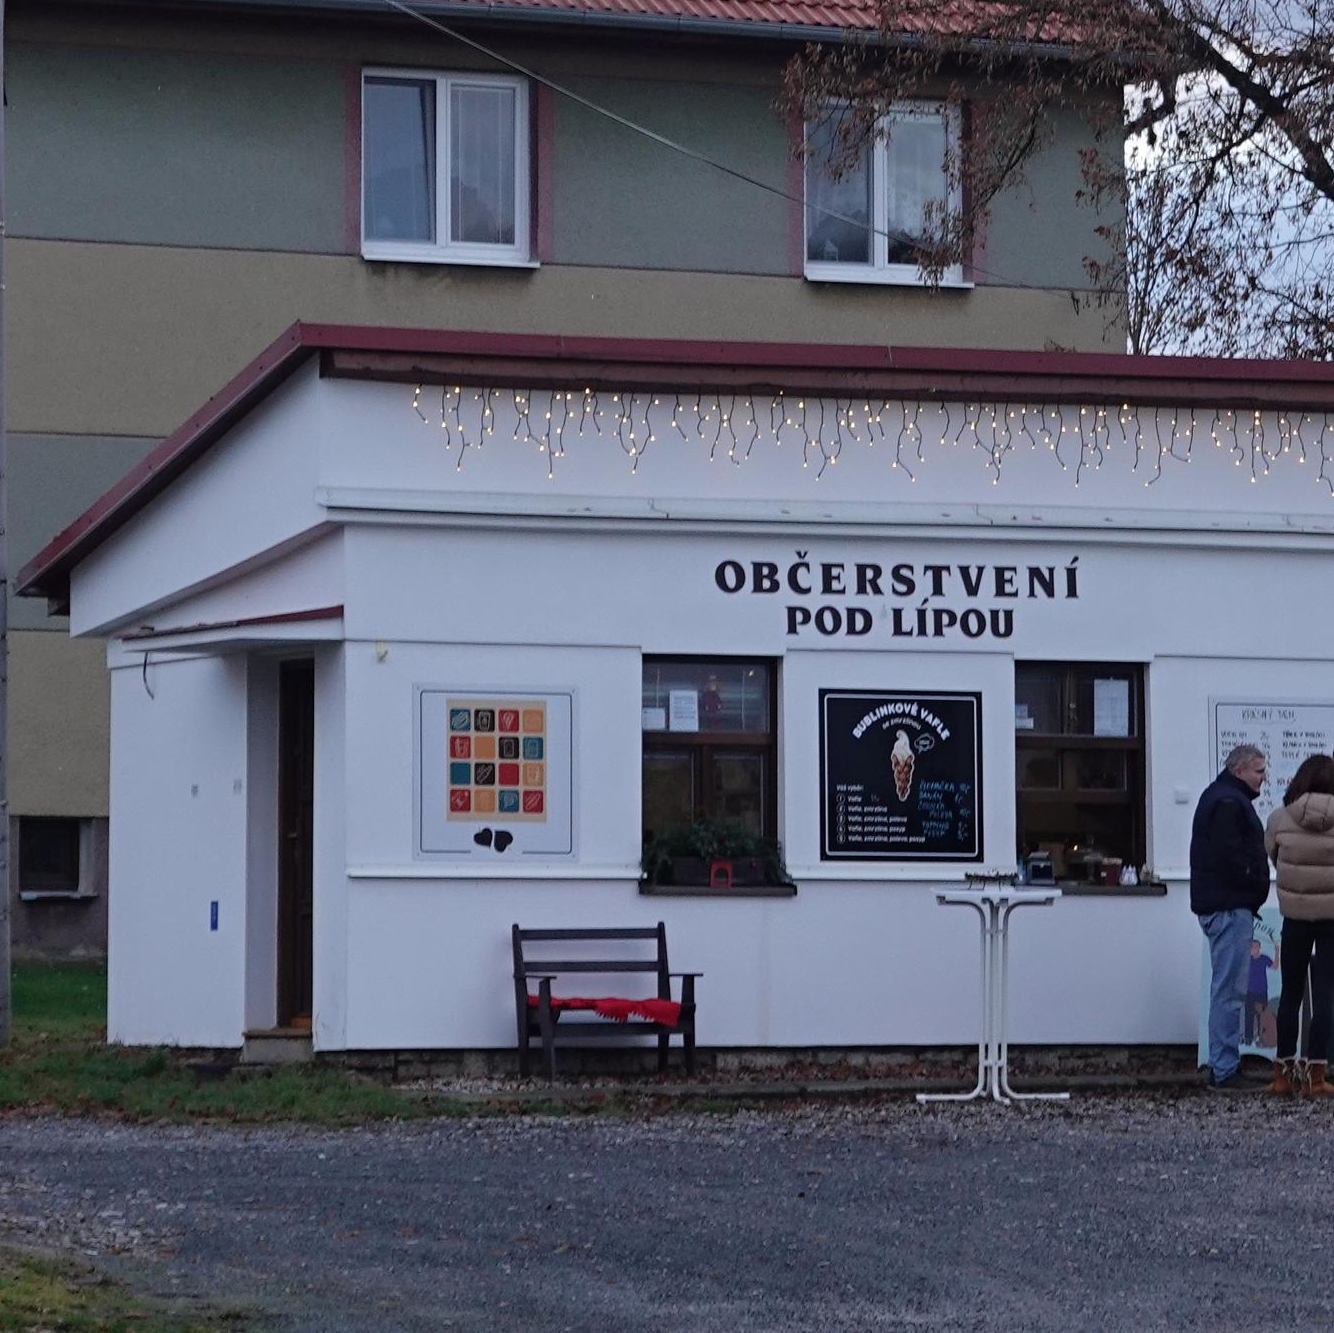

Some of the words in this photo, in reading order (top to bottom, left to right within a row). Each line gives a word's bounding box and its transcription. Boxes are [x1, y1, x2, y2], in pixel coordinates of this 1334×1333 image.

[714, 550, 1079, 599] OBČERSTVENÍ
[785, 605, 873, 636] POD
[891, 597, 1014, 638] LÍPOU
[852, 701, 919, 739] BUBLINKOVÉ
[920, 707, 951, 741] VAFLE
